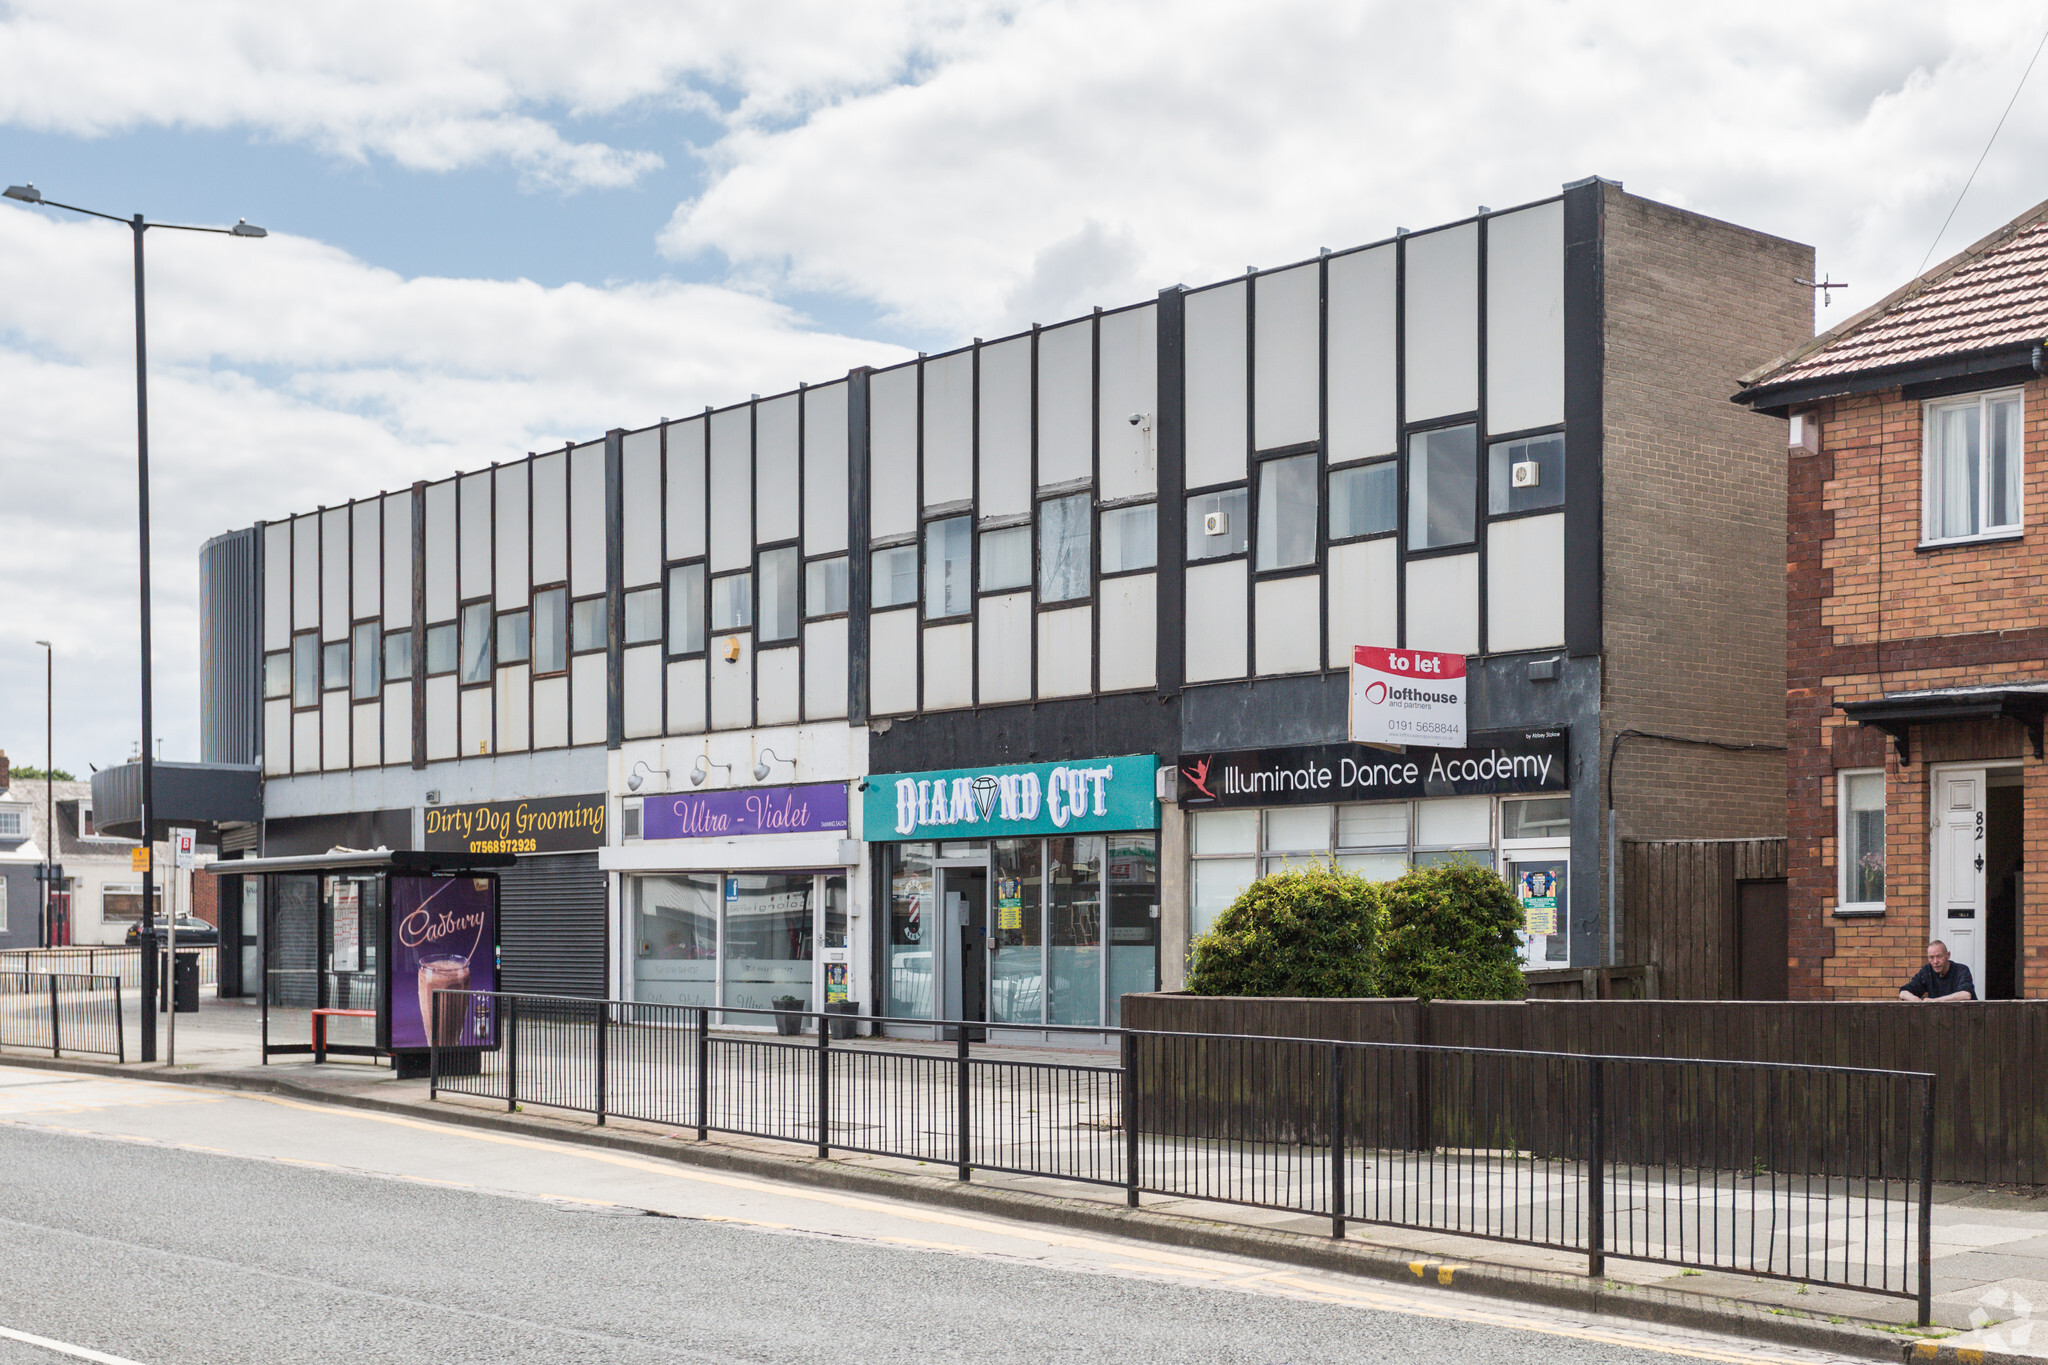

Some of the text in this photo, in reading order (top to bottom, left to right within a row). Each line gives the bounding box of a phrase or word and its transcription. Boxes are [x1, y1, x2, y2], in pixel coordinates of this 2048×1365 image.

[1388, 652, 1441, 674] to let
[1389, 686, 1458, 704] lofthouse
[1389, 700, 1432, 711] and partners
[1388, 719, 1459, 735] 0191 5658844
[1225, 748, 1553, 794] Illuminate Dance Academy
[673, 800, 732, 834] Ultra
[745, 793, 811, 830] Violet
[1046, 764, 1113, 829] CUT
[426, 801, 605, 840] Dirty Dog Grooming
[1974, 811, 1984, 841] 82
[399, 908, 485, 948] Cadbury
